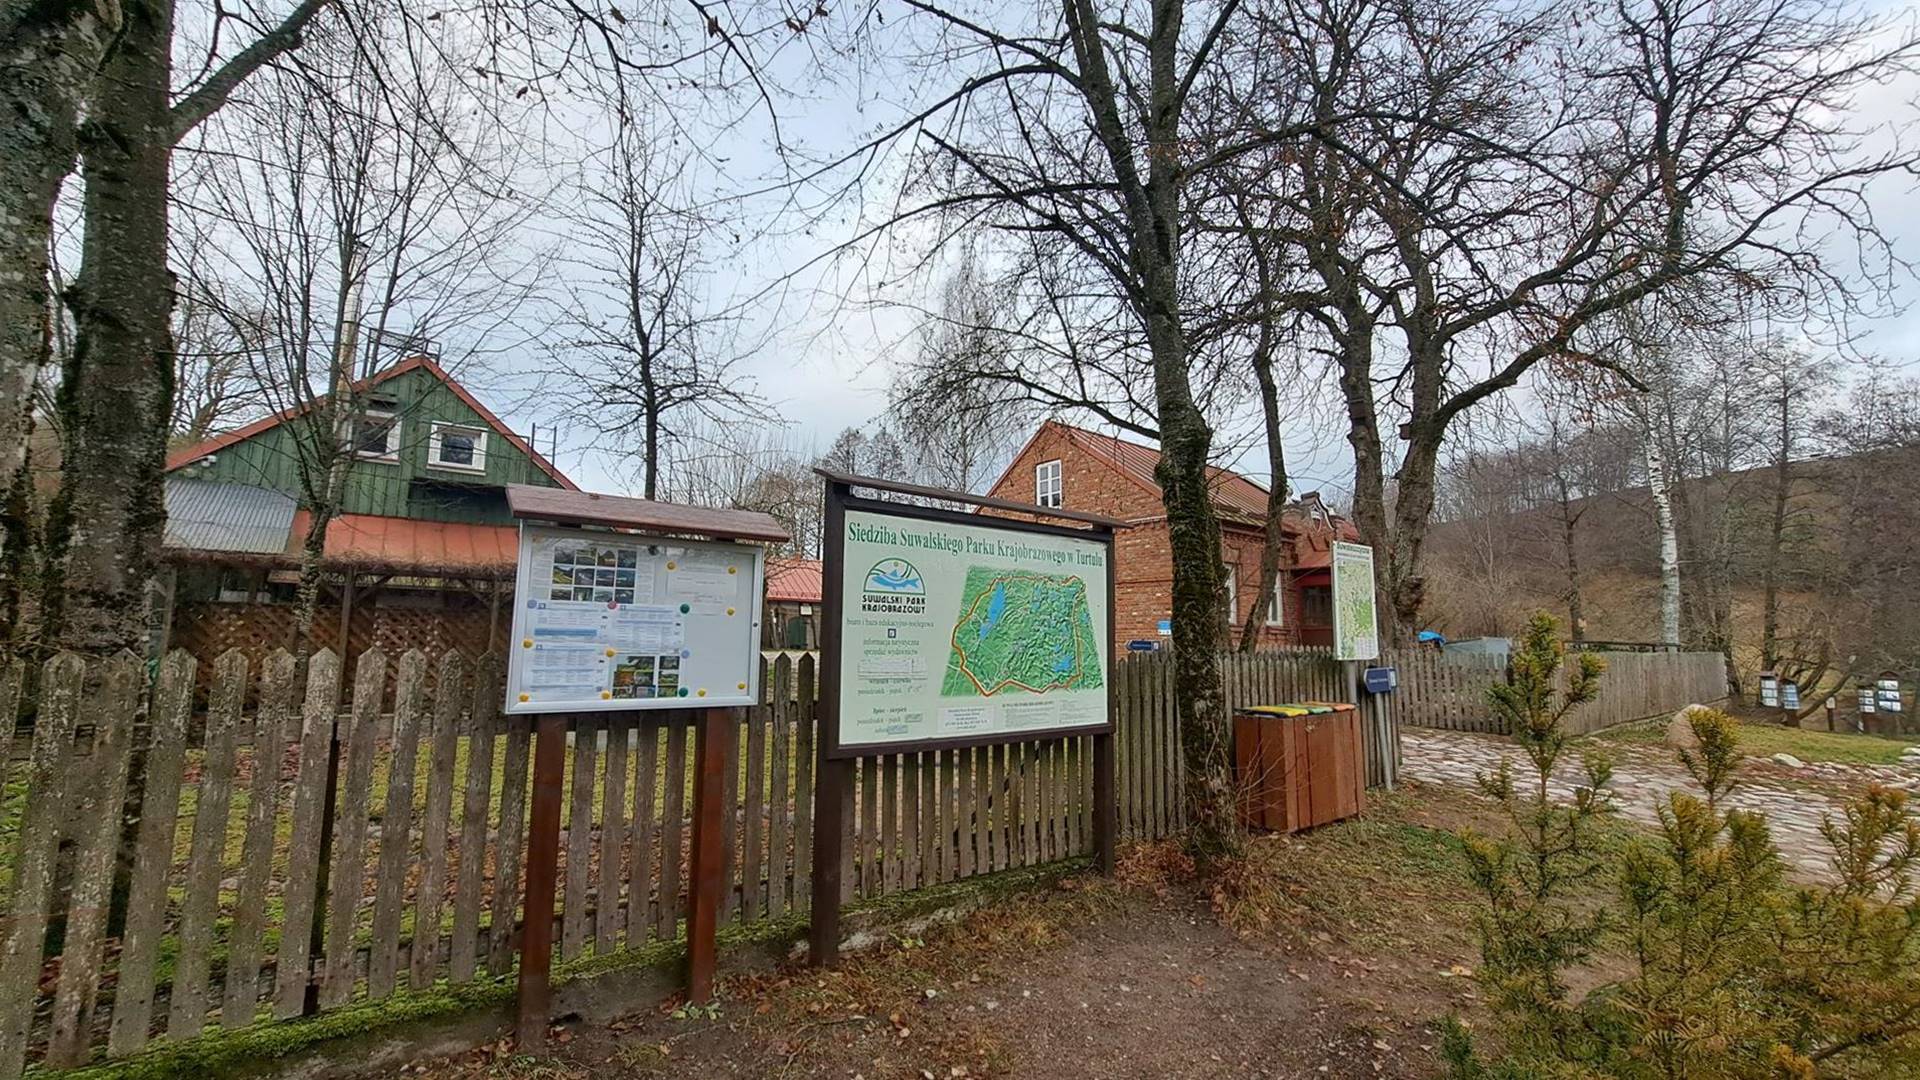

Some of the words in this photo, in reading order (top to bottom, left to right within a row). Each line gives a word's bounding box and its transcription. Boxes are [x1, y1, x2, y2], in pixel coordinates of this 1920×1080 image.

[849, 521, 897, 545] Siedziba
[900, 527, 963, 556] Suwalskiego
[966, 533, 995, 555] Parku
[997, 539, 1066, 566] Krajobrazowego
[1068, 554, 1075, 563] w
[1076, 549, 1103, 567] Turtulu
[862, 594, 902, 604] SUWALSKI
[906, 596, 926, 605] PARK
[862, 604, 925, 614] KRAJOBRAZOWY
